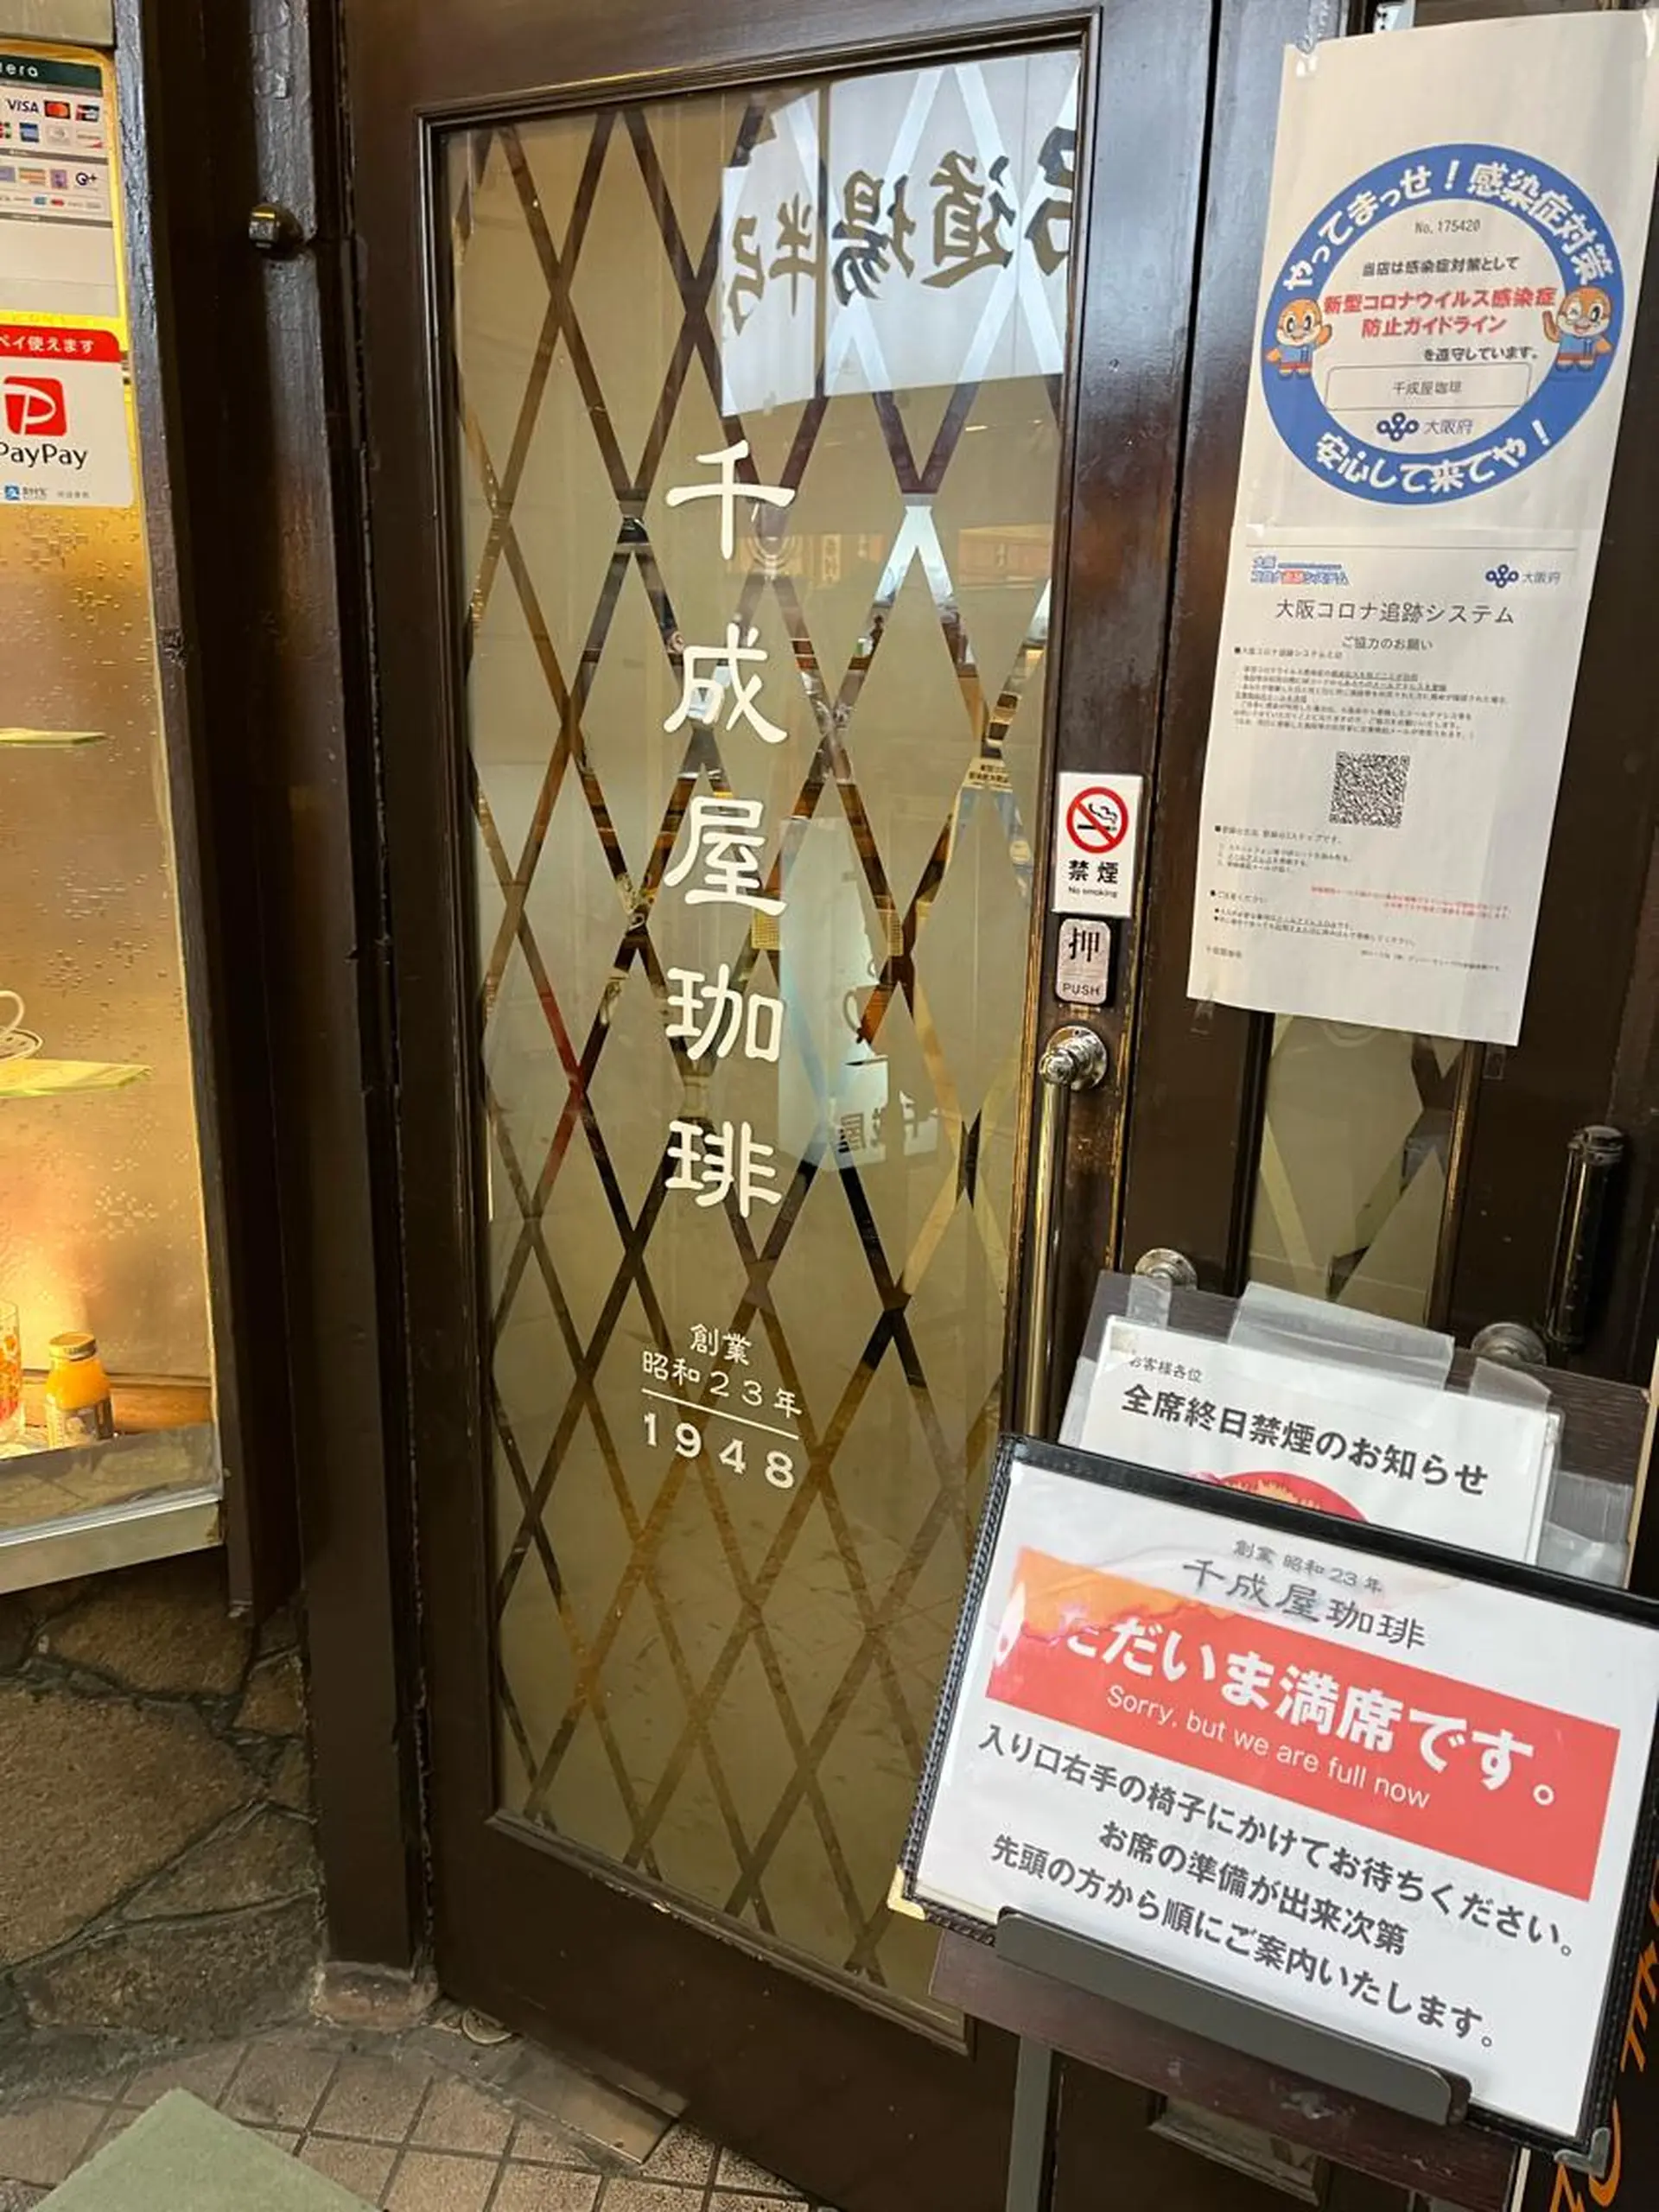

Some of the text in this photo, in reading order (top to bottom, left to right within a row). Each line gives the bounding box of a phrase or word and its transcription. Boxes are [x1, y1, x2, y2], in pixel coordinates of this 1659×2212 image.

[7, 98, 39, 113] VISA
[1323, 287, 1557, 315] 新型コロナウイルス感染症
[1361, 317, 1508, 339] 防止ガイドライン
[1424, 418, 1474, 435] 大阪府
[1276, 598, 1515, 625] 大阪コロナ追跡システム
[1342, 636, 1433, 651] ご協力のお願い
[664, 439, 796, 1219] 千成屋珈琲
[1068, 860, 1119, 884] 禁煙
[1068, 927, 1101, 963] 押
[1063, 982, 1101, 996] PUSH
[690, 1323, 753, 1366] 創業
[1129, 1354, 1205, 1384] お客様各位
[643, 1412, 795, 1490] 1948
[1121, 1382, 1489, 1497] 全席終日禁煙のお知らせ
[1232, 1539, 1277, 1566] 創業
[1182, 1558, 1427, 1650] 千成屋珈琲
[1185, 1713, 1225, 1743] but
[1233, 1732, 1269, 1758] we
[1275, 1745, 1319, 1773] are
[1327, 1757, 1366, 1789] full
[1373, 1776, 1430, 1811] now
[978, 1722, 1573, 1960] 入り口右手の椅子にかけてお待ちください。
[1098, 1820, 1408, 1958] お席の準備が出来次第
[992, 1832, 1497, 2050] 先頭の方から順にご案内いたします。
